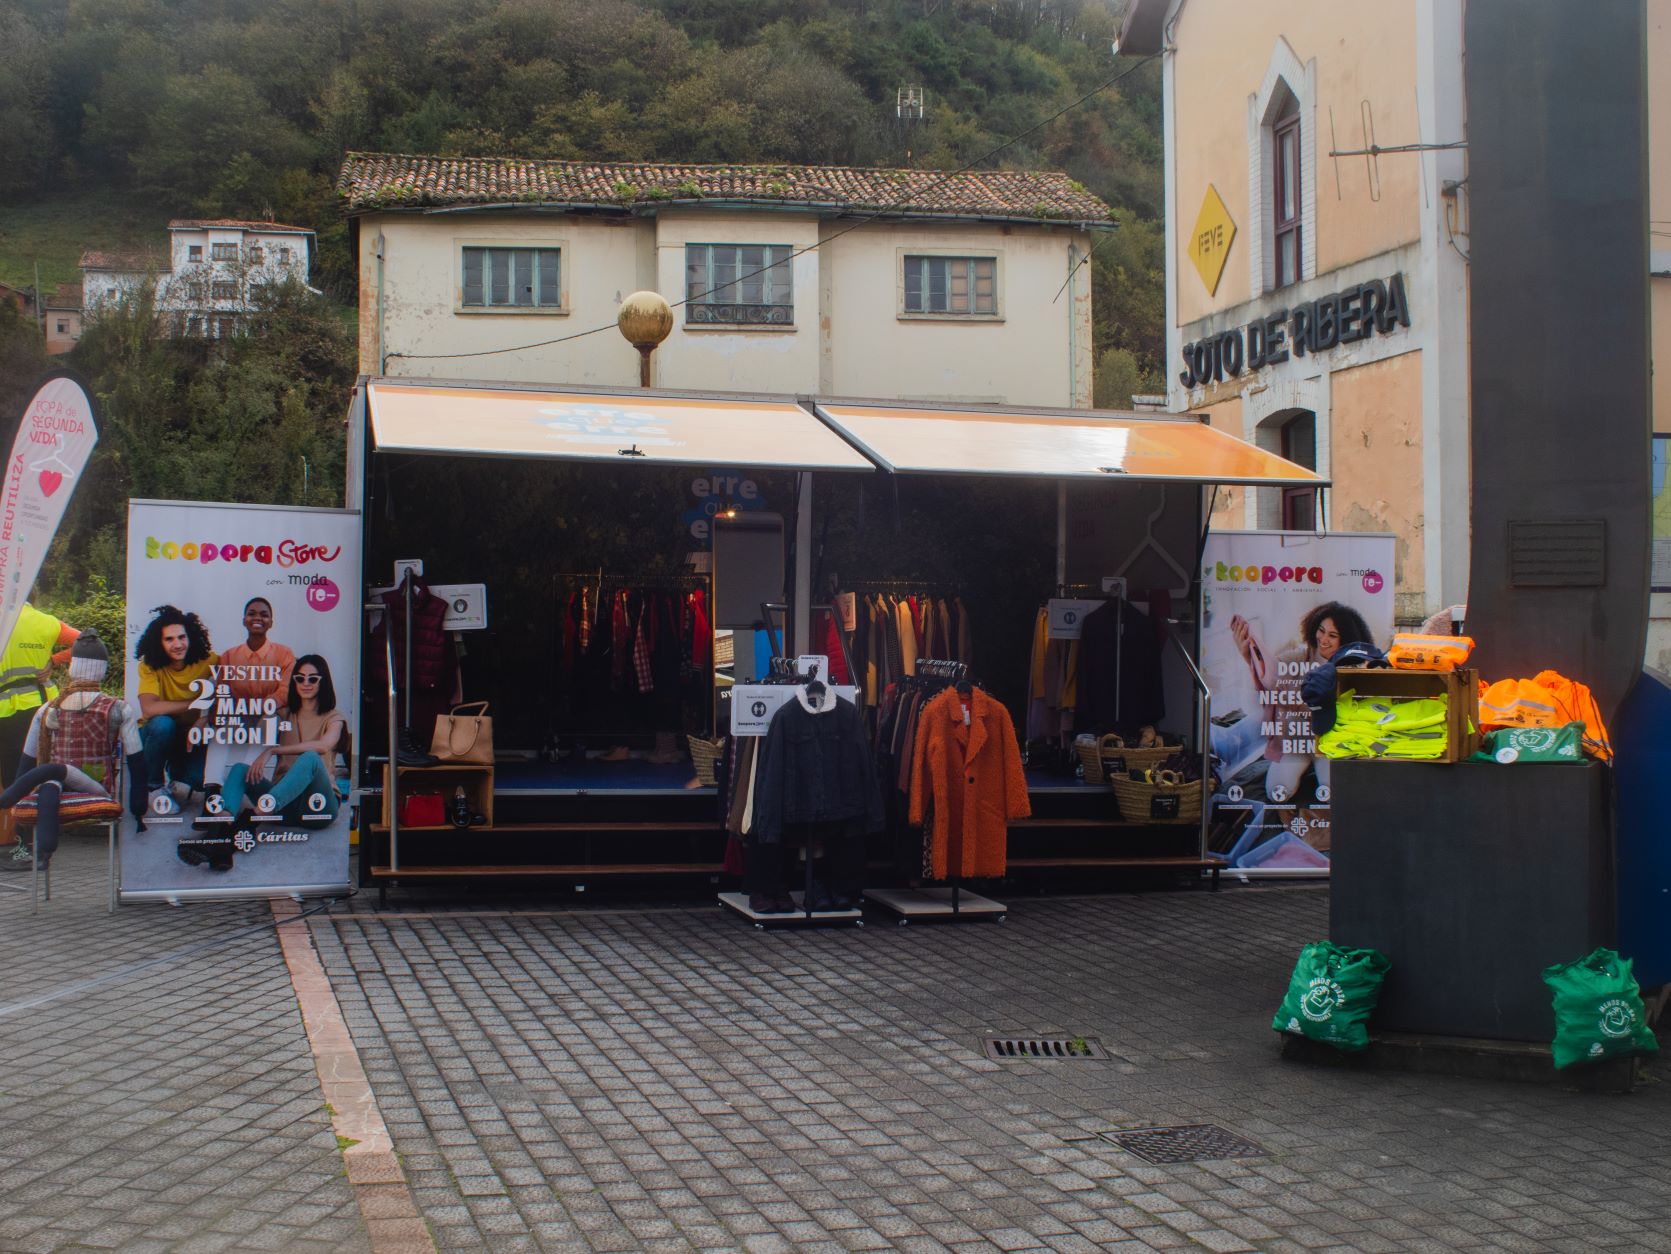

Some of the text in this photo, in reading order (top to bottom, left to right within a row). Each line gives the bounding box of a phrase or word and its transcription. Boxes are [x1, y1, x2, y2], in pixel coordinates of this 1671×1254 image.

[1198, 224, 1223, 257] FEVE
[1179, 271, 1411, 389] SOTO DE RIBERA
[32, 415, 84, 435] SEGUNDA
[29, 431, 57, 447] VIDA
[691, 475, 758, 499] erre
[2, 453, 25, 541] REUTILIZA
[145, 536, 342, 568] koopera Store
[287, 572, 329, 586] moda
[1215, 560, 1324, 586] koopera
[1350, 568, 1376, 577] moda
[208, 664, 283, 682] VESTIR
[216, 697, 277, 716] MANO
[215, 716, 227, 726] ES
[1260, 721, 1315, 736] ME SIE
[188, 724, 262, 746] OPCIÓN
[1282, 739, 1316, 754] BIEN
[1310, 817, 1331, 828] Cár
[257, 831, 309, 843] Cáritas
